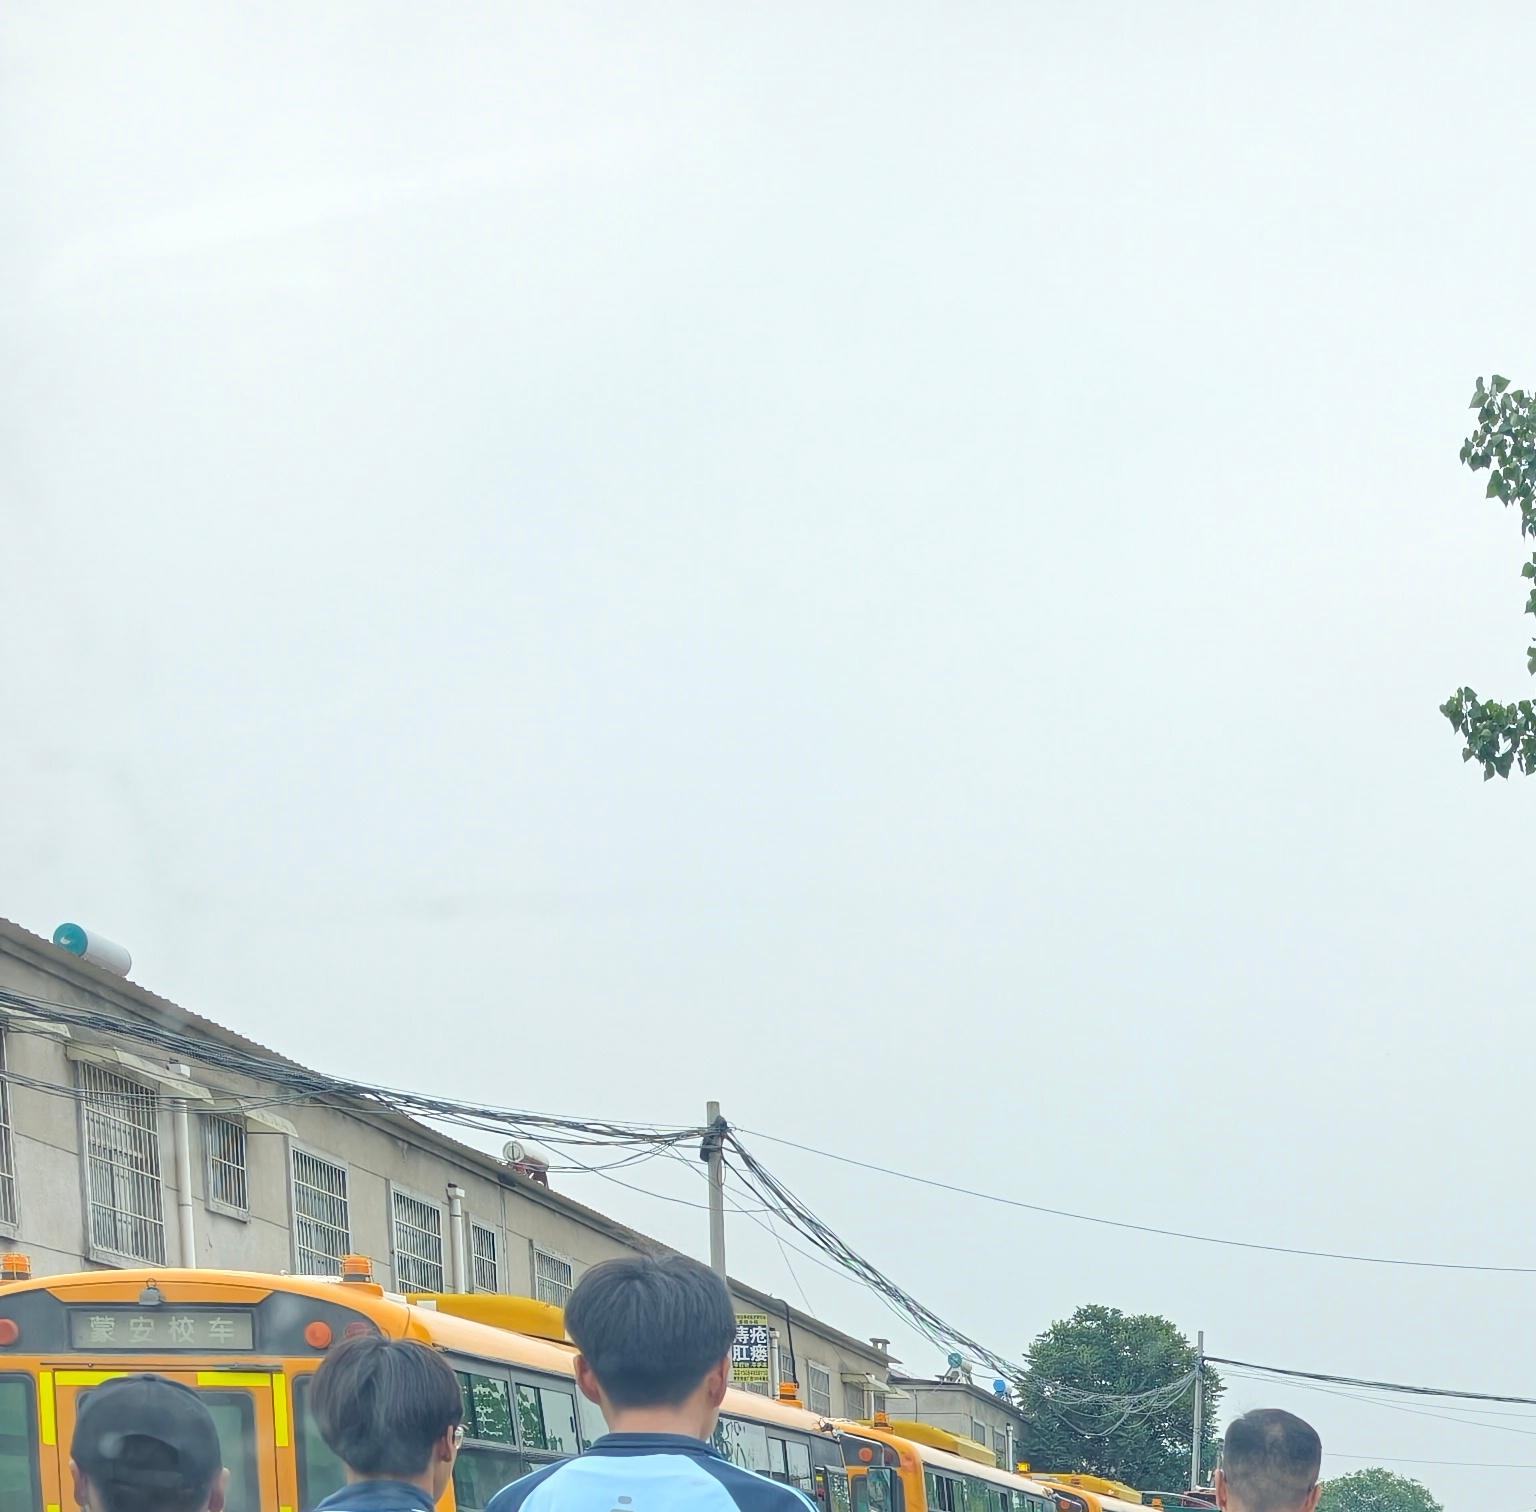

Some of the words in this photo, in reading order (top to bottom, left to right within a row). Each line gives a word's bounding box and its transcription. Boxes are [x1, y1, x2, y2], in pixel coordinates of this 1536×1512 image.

[89, 1315, 235, 1344] 蒙安校车
[733, 1325, 767, 1344] 痔疮
[732, 1344, 768, 1362] 肛瘘
